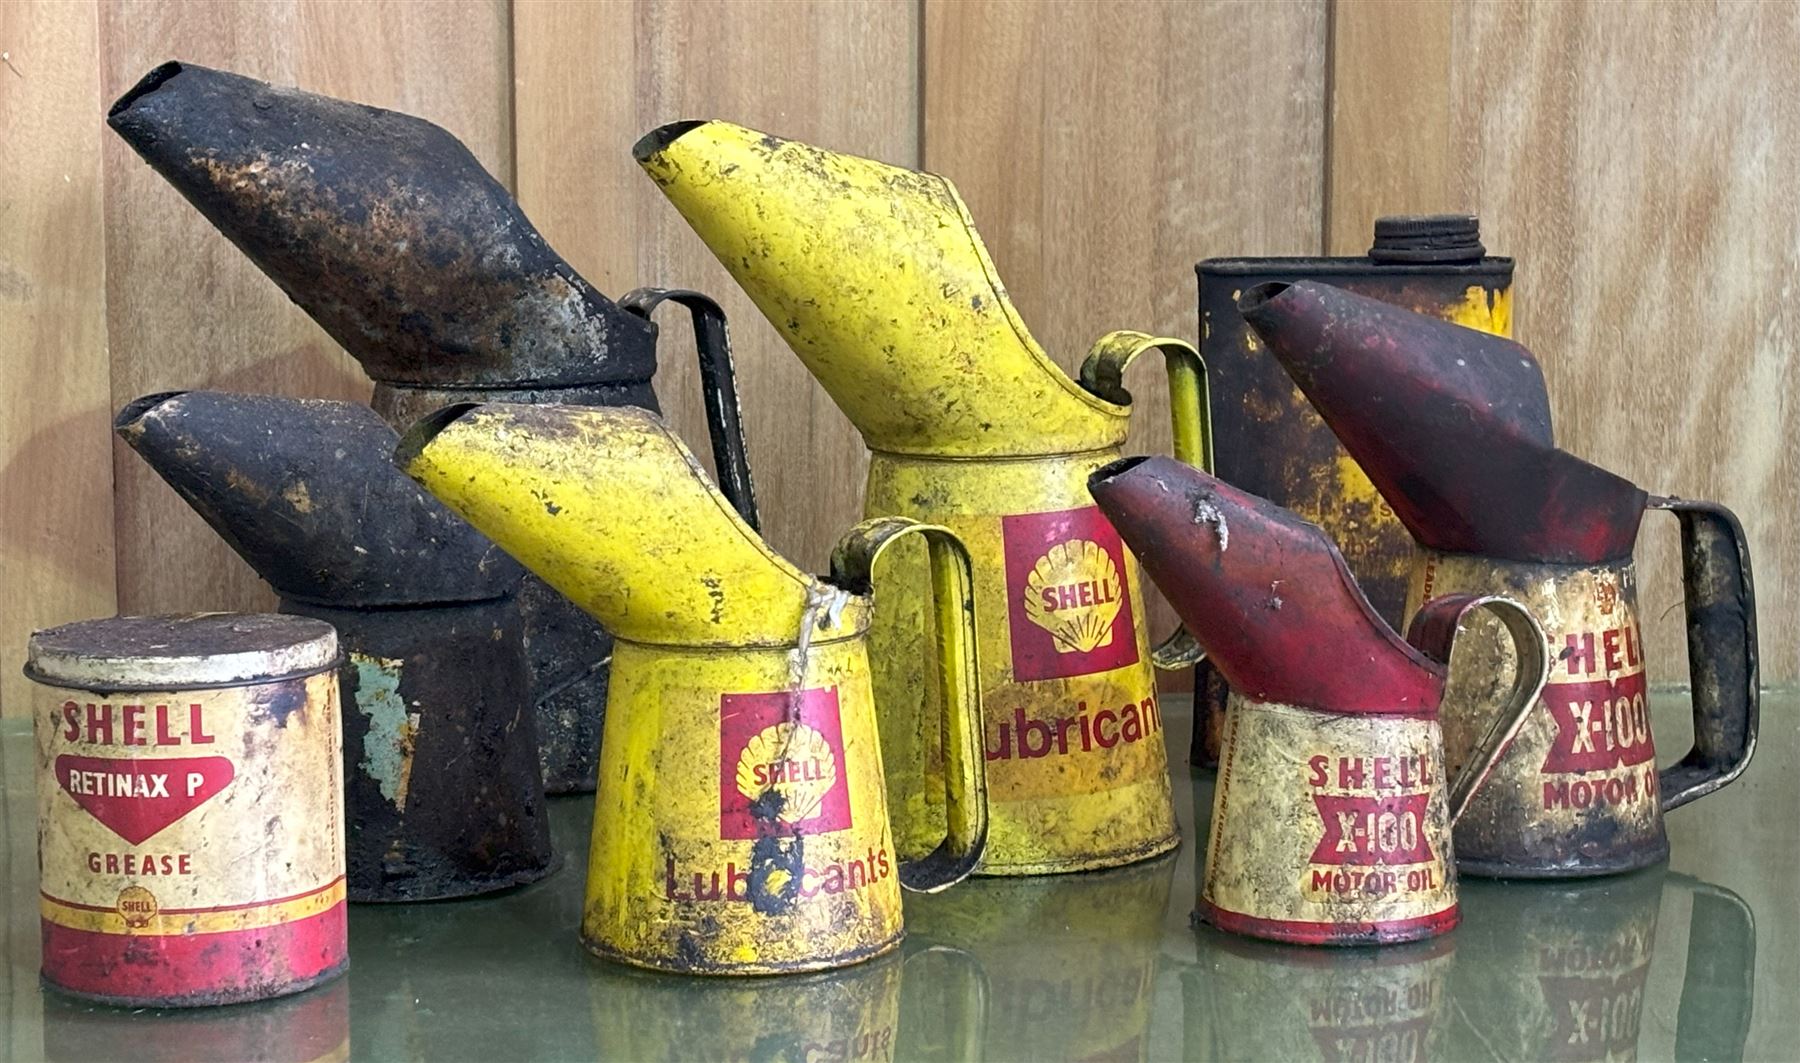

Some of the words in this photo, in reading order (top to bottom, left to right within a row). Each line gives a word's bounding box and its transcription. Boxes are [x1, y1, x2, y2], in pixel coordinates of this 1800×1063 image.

[1041, 578, 1115, 612] SHELL
[63, 700, 216, 746] SHELL
[1568, 691, 1649, 755] X-100
[69, 769, 170, 798] RETINAX
[187, 772, 205, 797] P
[752, 757, 828, 787] SHELL
[1308, 754, 1434, 789] SHELL
[1543, 773, 1637, 809] MOTOR
[1335, 811, 1418, 853] X-100
[88, 852, 192, 876] GREASE
[665, 847, 890, 902] Lubcants
[1311, 870, 1398, 893] MOTOR
[1407, 868, 1437, 892] OIL
[122, 901, 152, 912] SHELL
